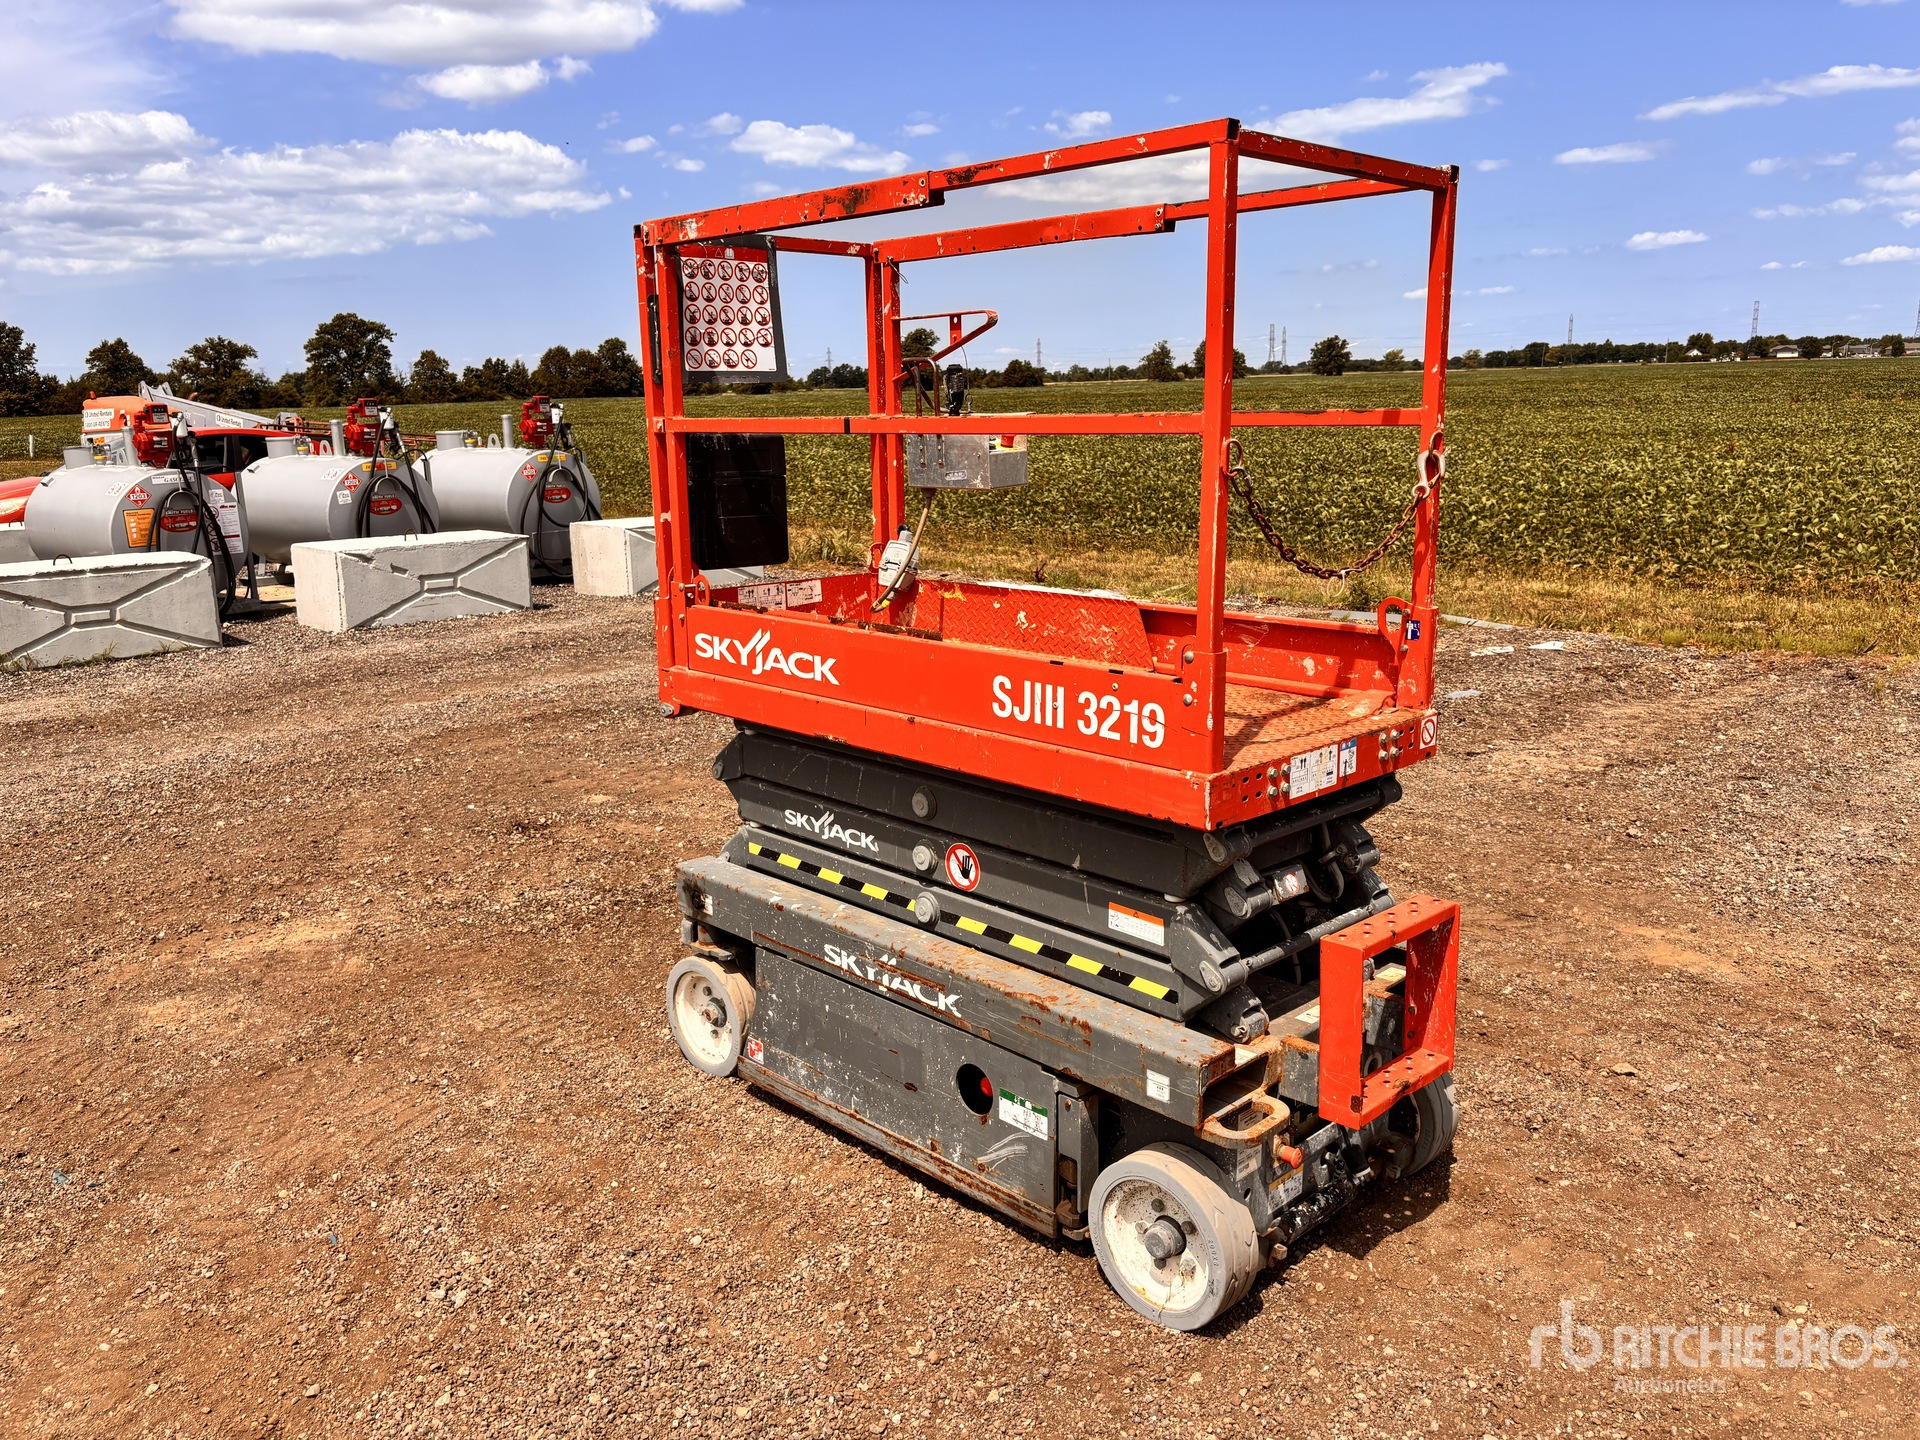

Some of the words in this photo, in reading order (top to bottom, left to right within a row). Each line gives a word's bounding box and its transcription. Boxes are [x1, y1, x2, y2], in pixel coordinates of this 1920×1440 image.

[231, 418, 242, 428] Rentals
[694, 628, 840, 685] SKYJACK
[992, 675, 1064, 729] SJIII
[1077, 691, 1165, 748] 3219
[784, 810, 878, 851] SKYJACK
[823, 943, 962, 1018] SKYJACK
